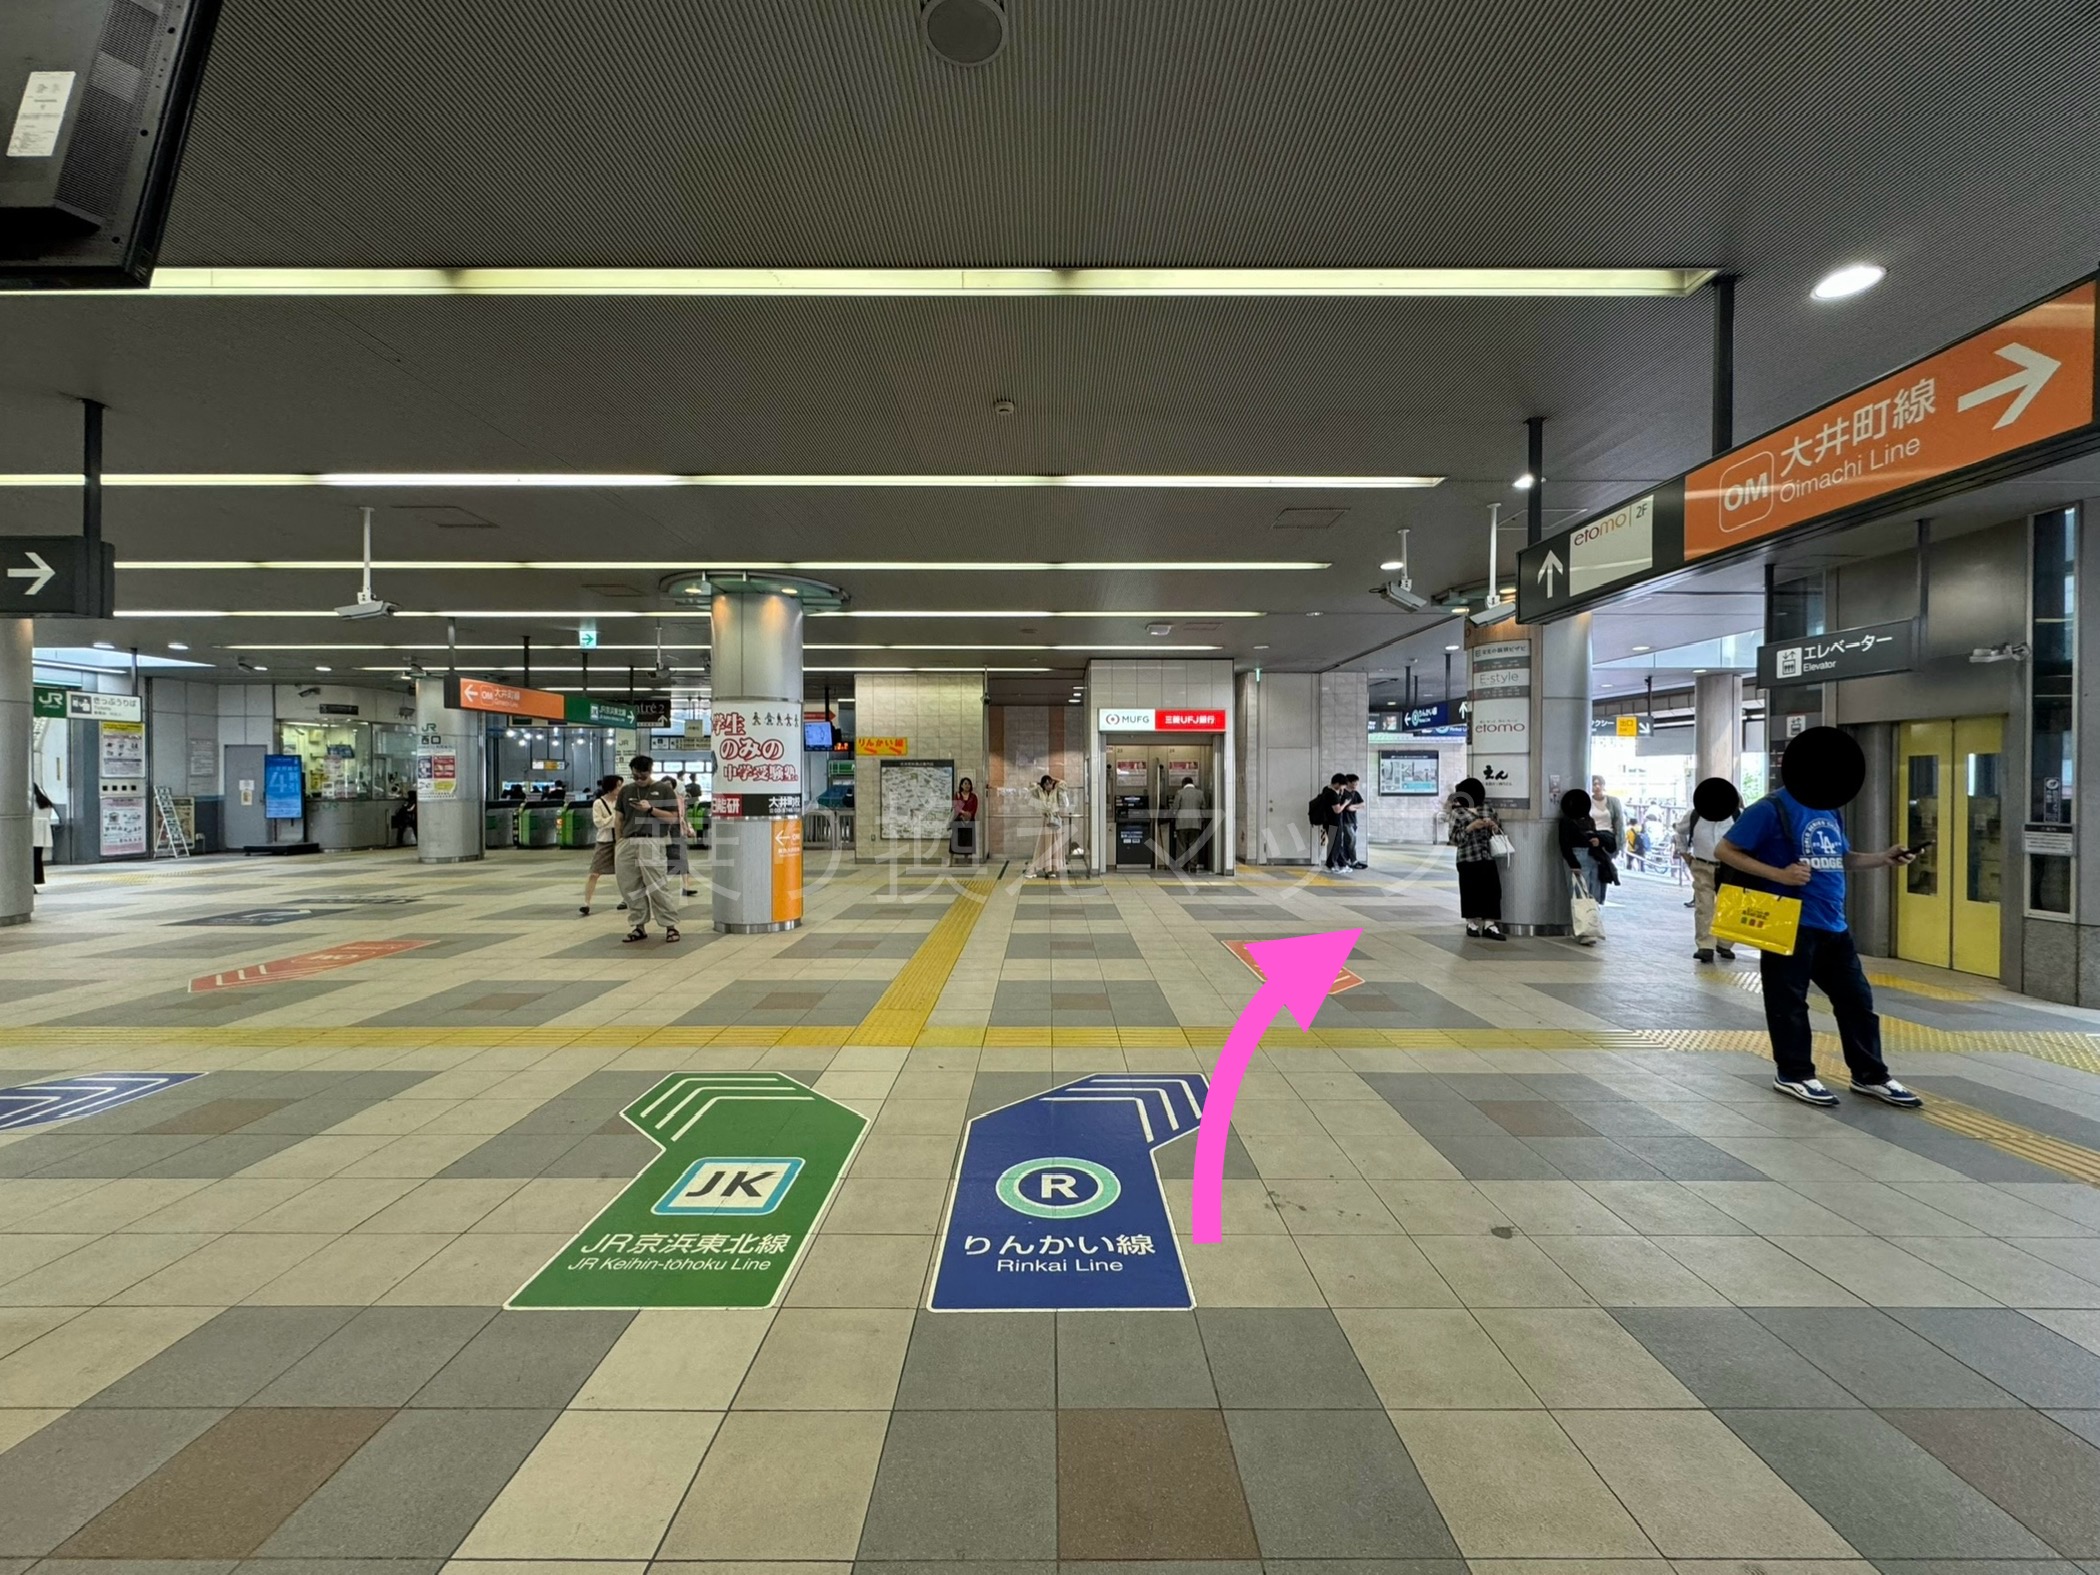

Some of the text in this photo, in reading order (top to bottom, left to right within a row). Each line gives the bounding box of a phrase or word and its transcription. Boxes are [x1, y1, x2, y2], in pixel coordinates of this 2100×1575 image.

[1780, 378, 1936, 477] 大井町線
[1780, 438, 1921, 503] Ōimachi Line
[1723, 472, 1769, 511] OM
[1574, 503, 1648, 546] etomo 2F
[1803, 634, 1893, 660] エレベーター
[1479, 671, 1519, 684] E-style
[1803, 661, 1837, 673] Elevator
[38, 692, 64, 706] JR
[421, 723, 437, 732] JR
[1122, 715, 1150, 724] MUFG
[1475, 723, 1525, 734] etomo
[421, 735, 442, 745] 西口
[720, 737, 785, 761] のみの
[1483, 765, 1509, 780] えん
[1816, 831, 1837, 854] LA
[685, 1171, 777, 1198] JK
[1040, 1173, 1079, 1199] R
[580, 1232, 792, 1255] JR京浜東北線
[964, 1233, 1156, 1256] りんかい線
[567, 1256, 600, 1271] JR
[730, 1256, 772, 1271] Line
[996, 1258, 1124, 1272] Rinkai Line
